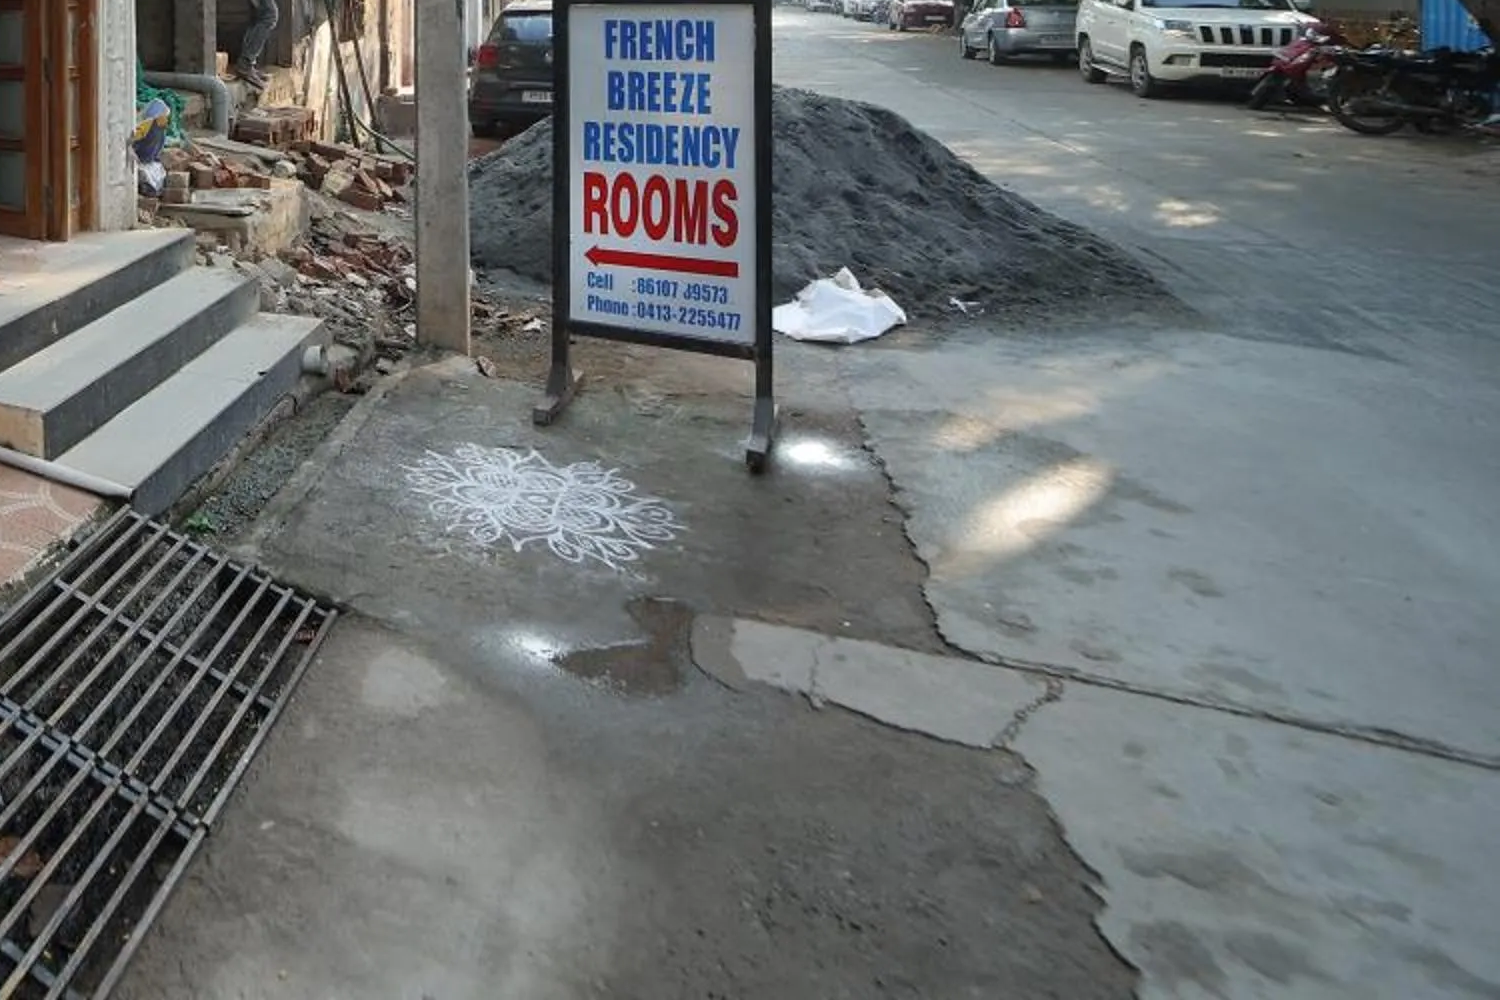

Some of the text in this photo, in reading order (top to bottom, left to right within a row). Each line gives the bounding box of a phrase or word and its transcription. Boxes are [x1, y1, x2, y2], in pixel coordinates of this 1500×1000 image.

[604, 19, 715, 62] FRENCH
[607, 70, 712, 115] BREEZE
[583, 121, 740, 169] RESIDENCY
[583, 171, 739, 248] ROOMS
[587, 271, 613, 290] Cell
